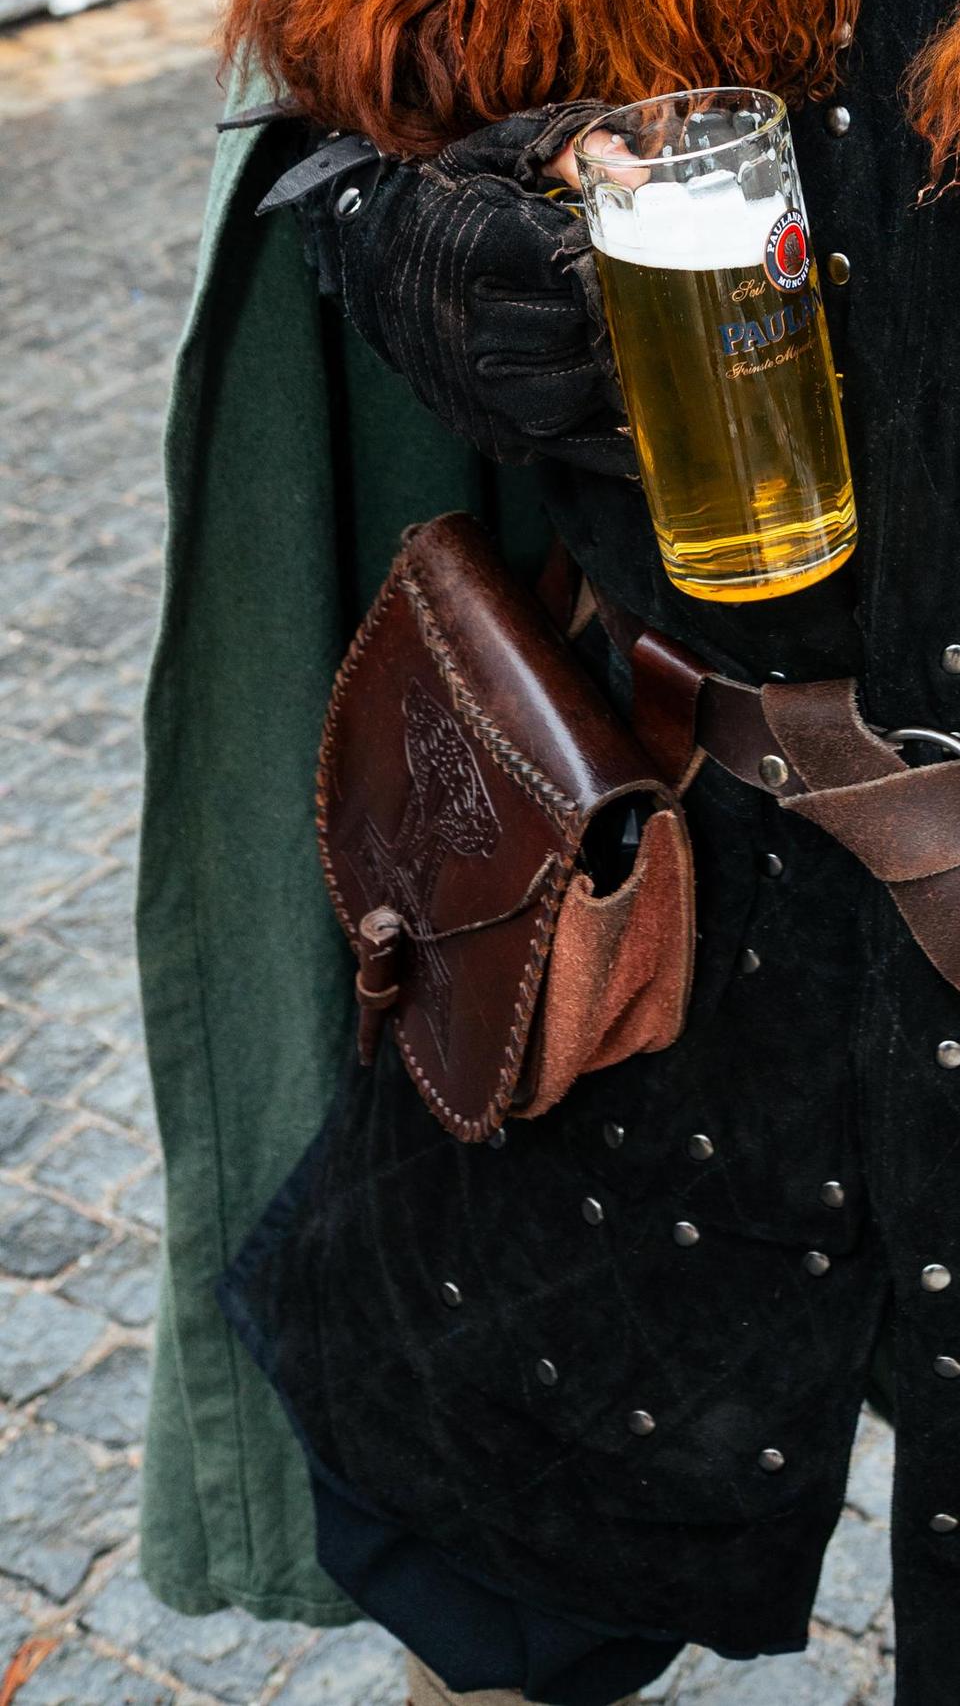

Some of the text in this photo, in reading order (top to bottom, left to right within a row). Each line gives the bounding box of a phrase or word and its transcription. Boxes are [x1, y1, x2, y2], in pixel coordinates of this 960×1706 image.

[777, 257, 810, 289] MÜNCHEN
[730, 278, 766, 302] Seit
[719, 294, 817, 356] PAULA
[725, 357, 774, 379] Feinste
